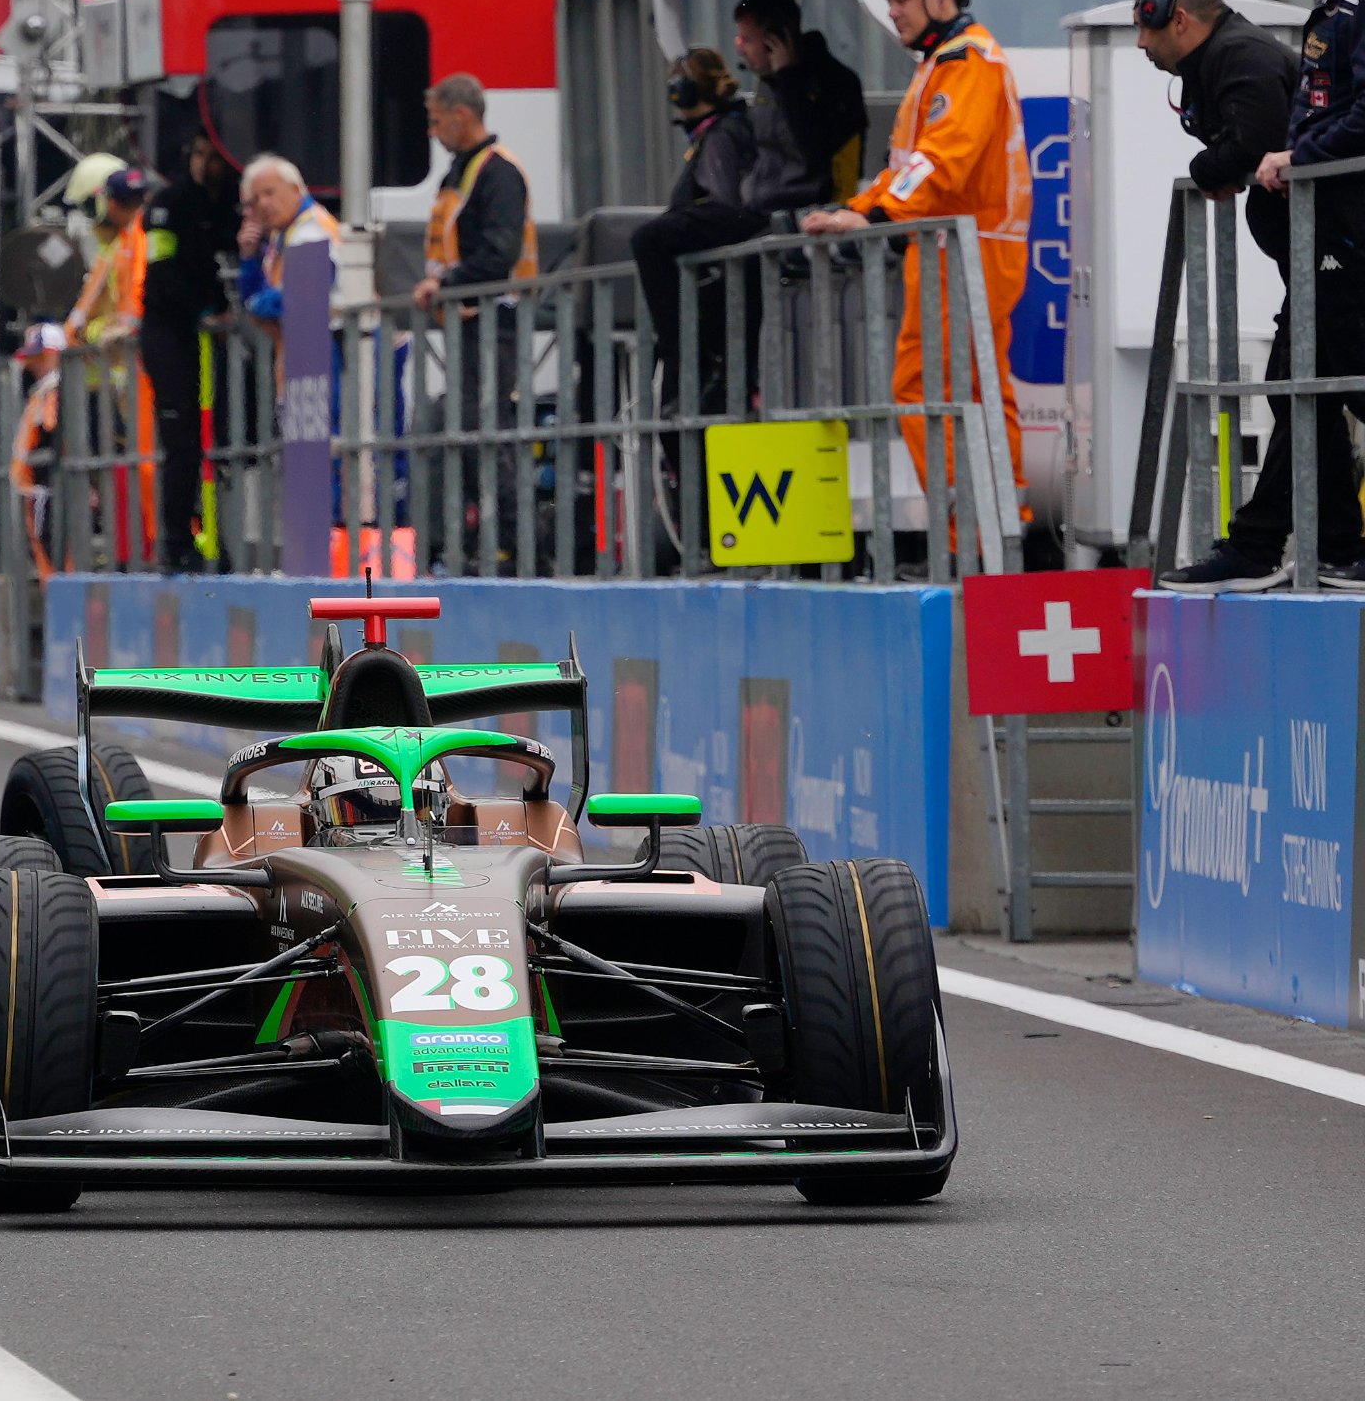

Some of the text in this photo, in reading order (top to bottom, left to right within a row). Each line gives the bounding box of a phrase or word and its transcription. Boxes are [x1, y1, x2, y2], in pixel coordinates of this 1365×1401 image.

[128, 672, 183, 682] AIX
[417, 668, 527, 681] GROUP
[1290, 719, 1327, 811] NOW
[1145, 662, 1268, 909] Paramount+
[1282, 833, 1342, 911] STREAMING
[385, 929, 510, 945] FIVE
[384, 955, 519, 1013] 28
[416, 1033, 503, 1044] aramco
[413, 1046, 510, 1056] advanced fuel
[413, 1059, 510, 1074] PIRELLI
[427, 1079, 497, 1088] dallara
[616, 1123, 772, 1133] INVESTMENT
[779, 1121, 869, 1129] GROUP
